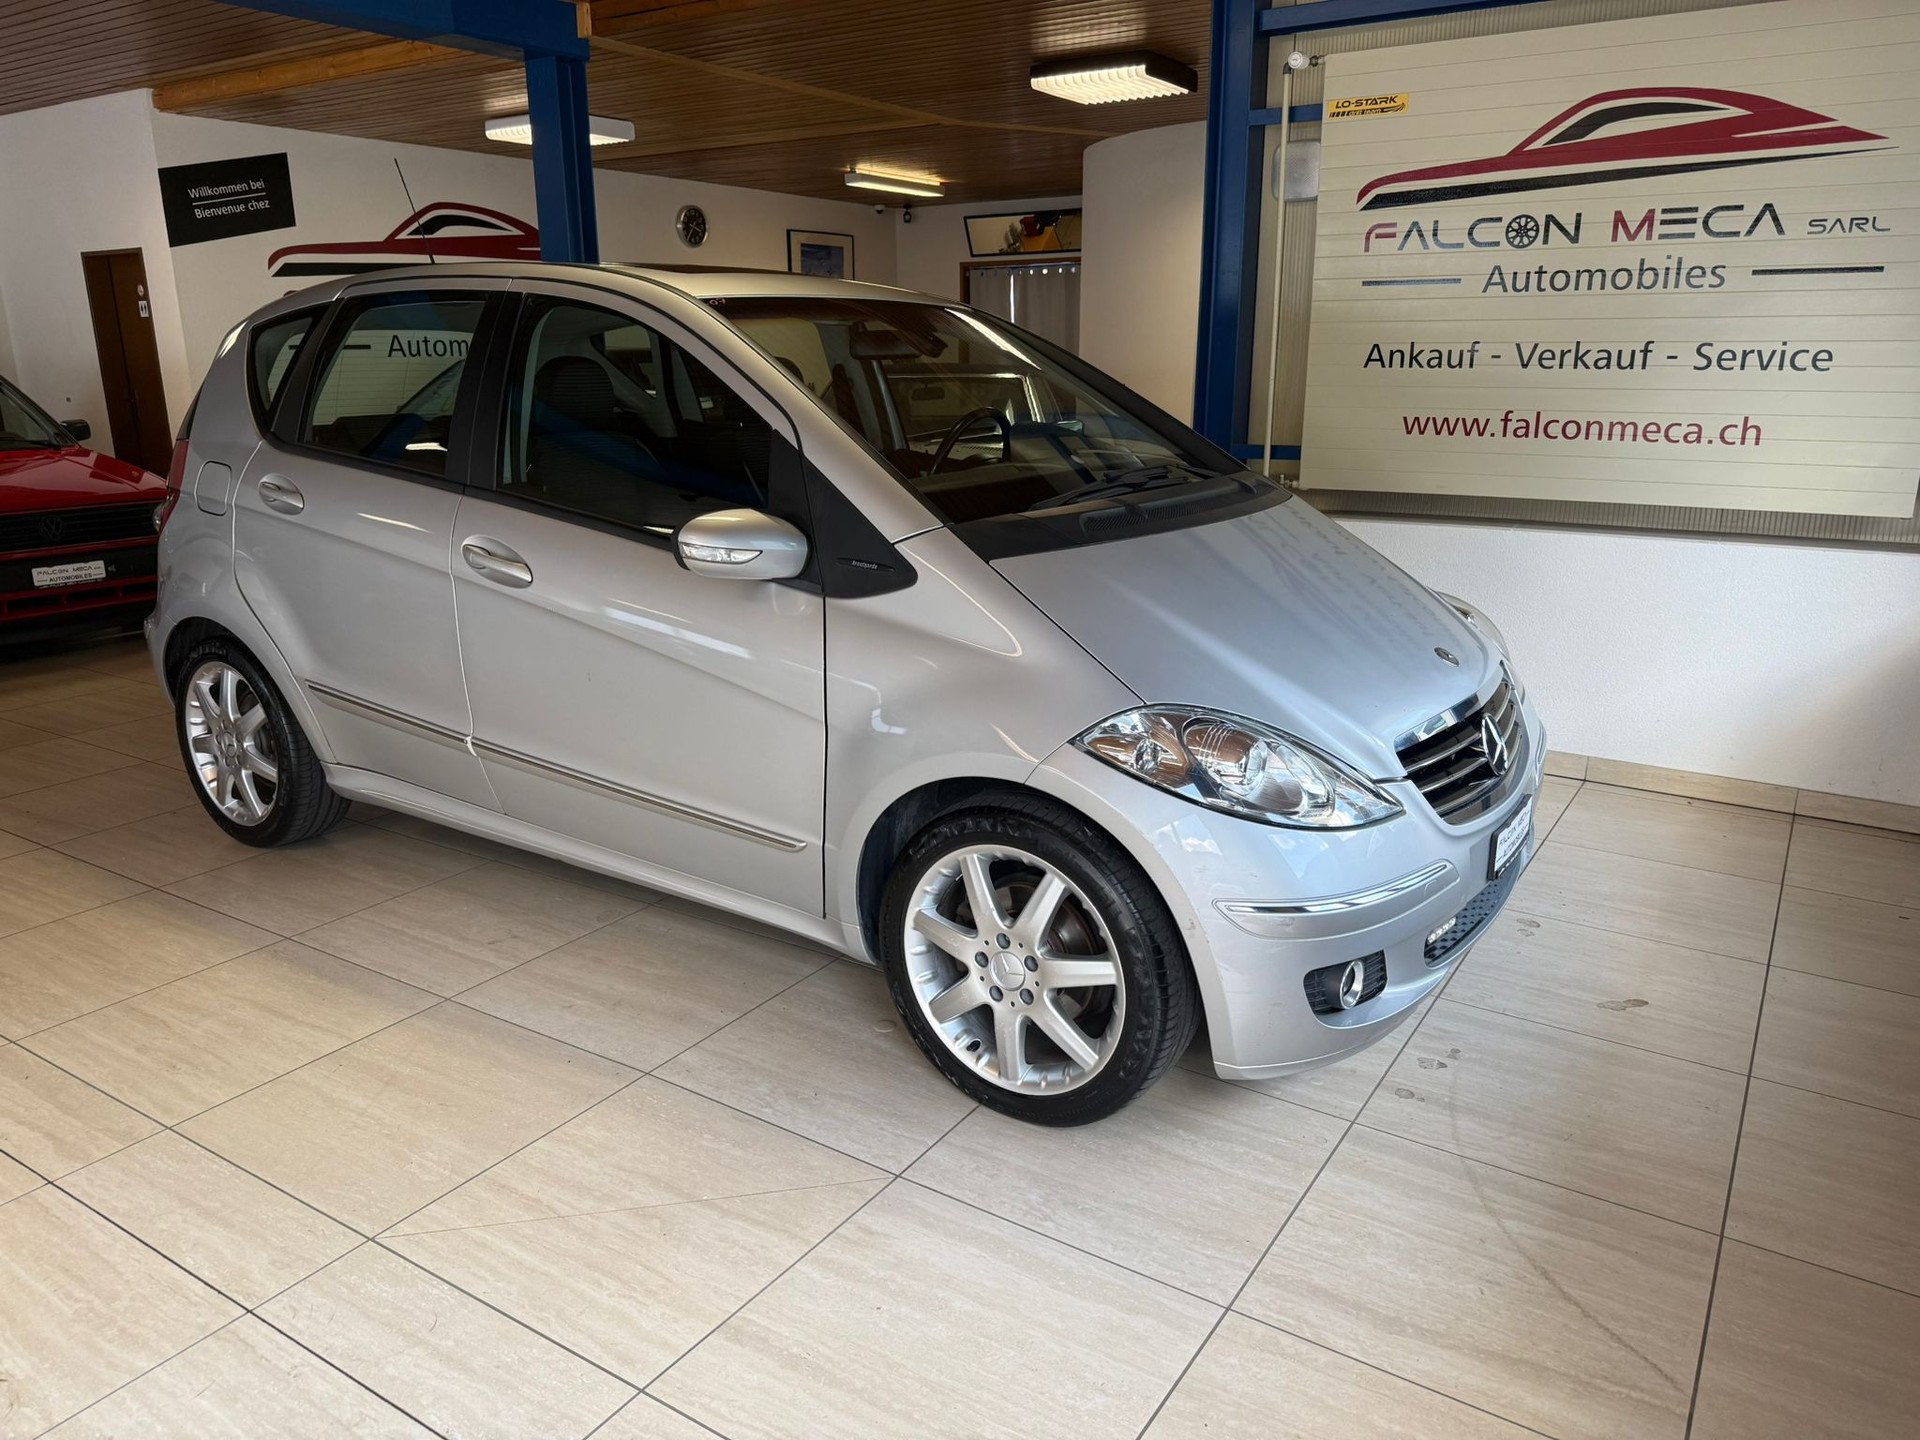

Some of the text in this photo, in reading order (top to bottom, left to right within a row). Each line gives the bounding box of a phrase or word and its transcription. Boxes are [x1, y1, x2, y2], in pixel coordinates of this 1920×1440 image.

[1335, 95, 1399, 109] LO-STARK
[188, 178, 265, 198] Willkommen bei
[194, 199, 271, 219] Bienvenue chez
[1364, 203, 1892, 253] FALCON MECA SARL
[1481, 255, 1727, 294] Automobiles
[1363, 341, 1481, 370] Ankauf
[1515, 341, 1654, 371] Verkauf
[1693, 342, 1835, 372] Service
[1402, 410, 1763, 447] www.falconmeca.ch
[49, 572, 93, 583] AUTOMOBILES
